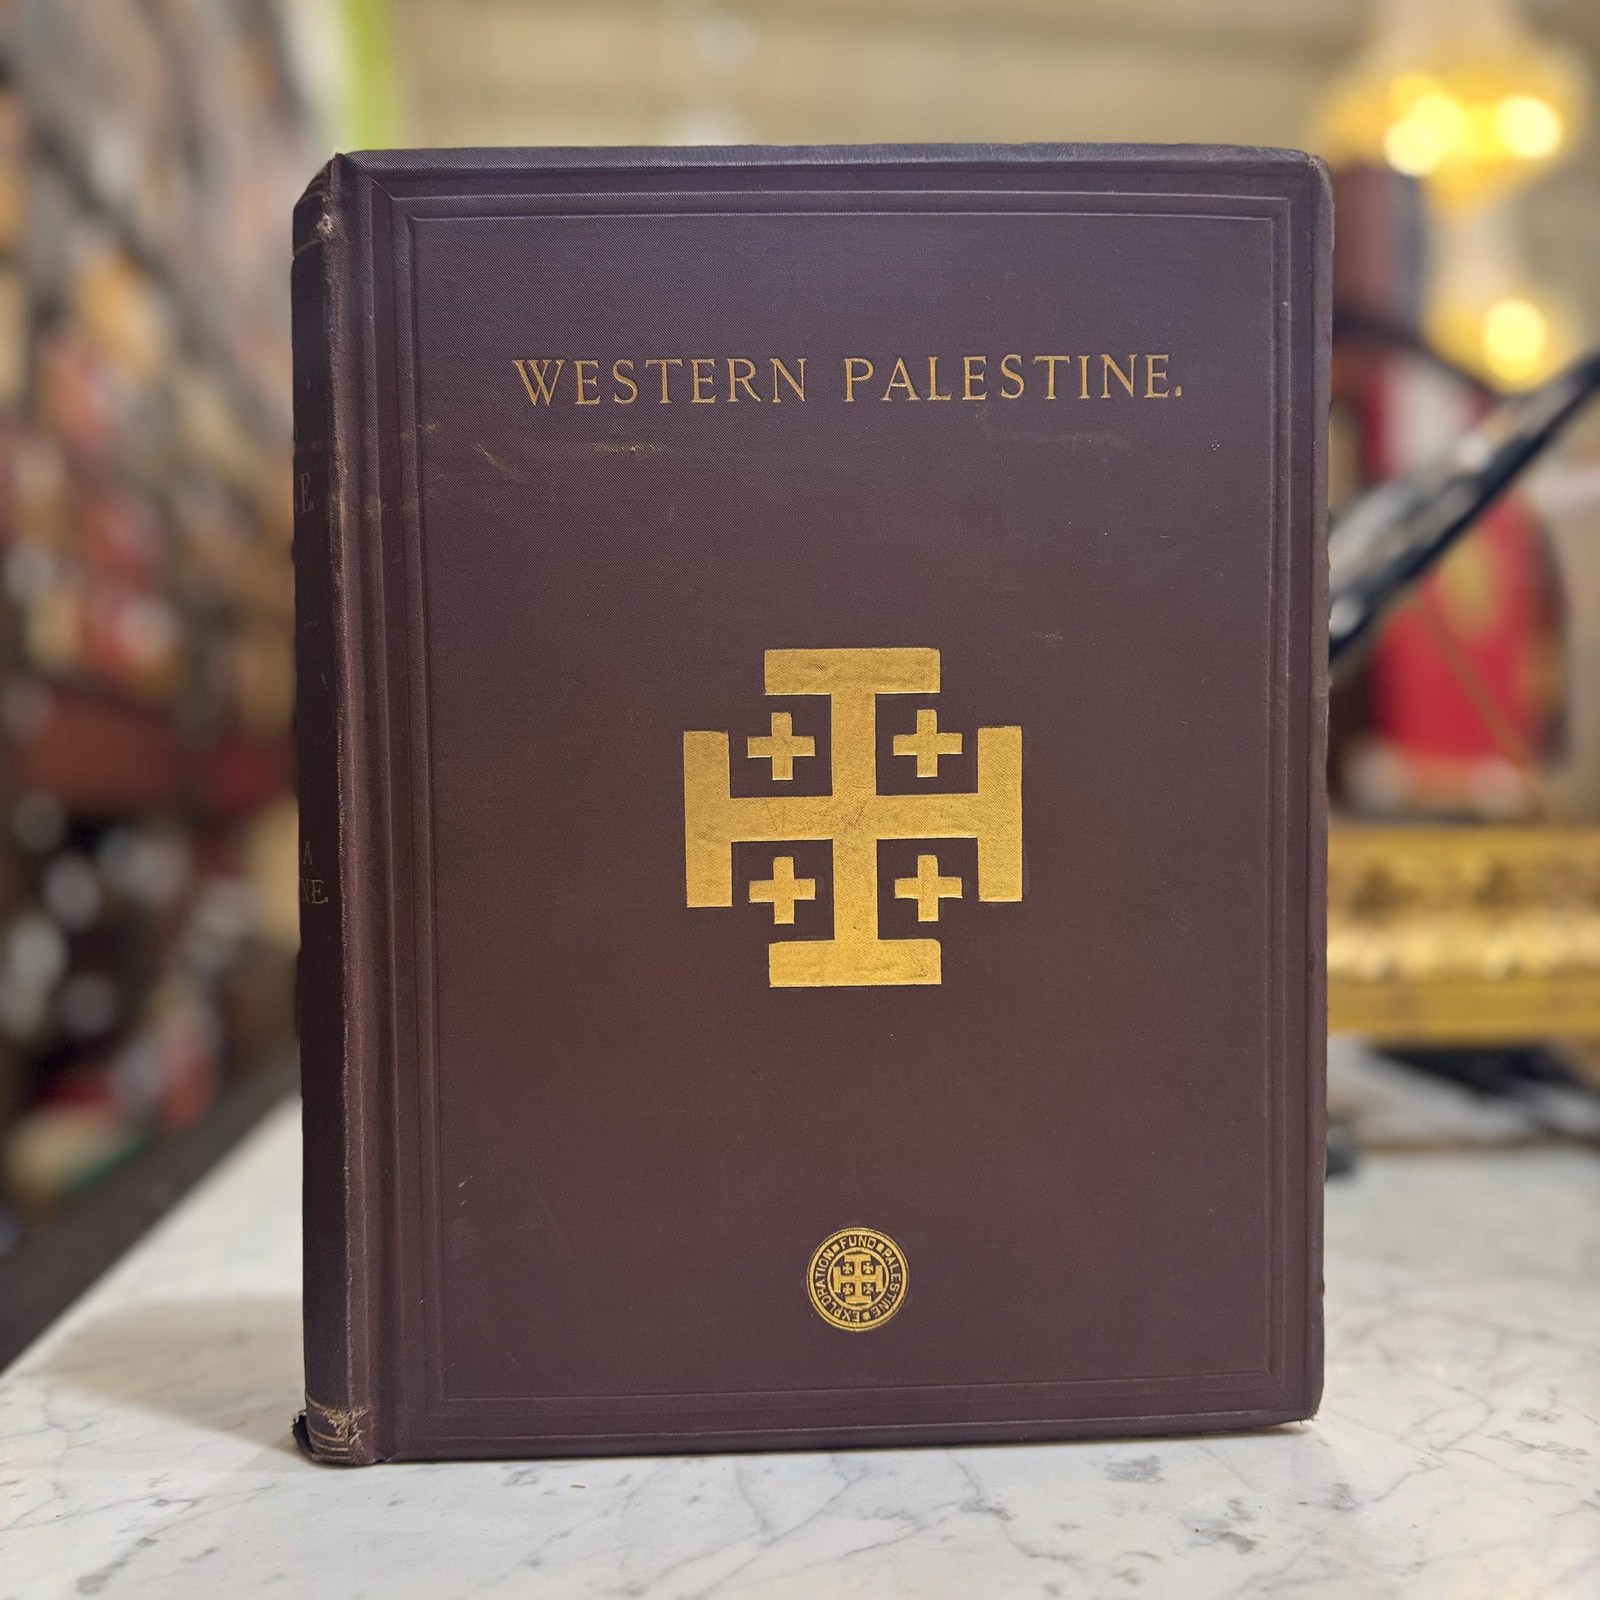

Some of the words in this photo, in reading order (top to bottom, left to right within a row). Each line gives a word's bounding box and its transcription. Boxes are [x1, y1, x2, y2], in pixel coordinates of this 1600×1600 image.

[513, 358, 808, 406] WESTERN
[843, 353, 1183, 402] PALESTINE.
[839, 1235, 877, 1249] FUND
[815, 1247, 860, 1322] EXPLORATION
[870, 1247, 902, 1319] PALESTINE
